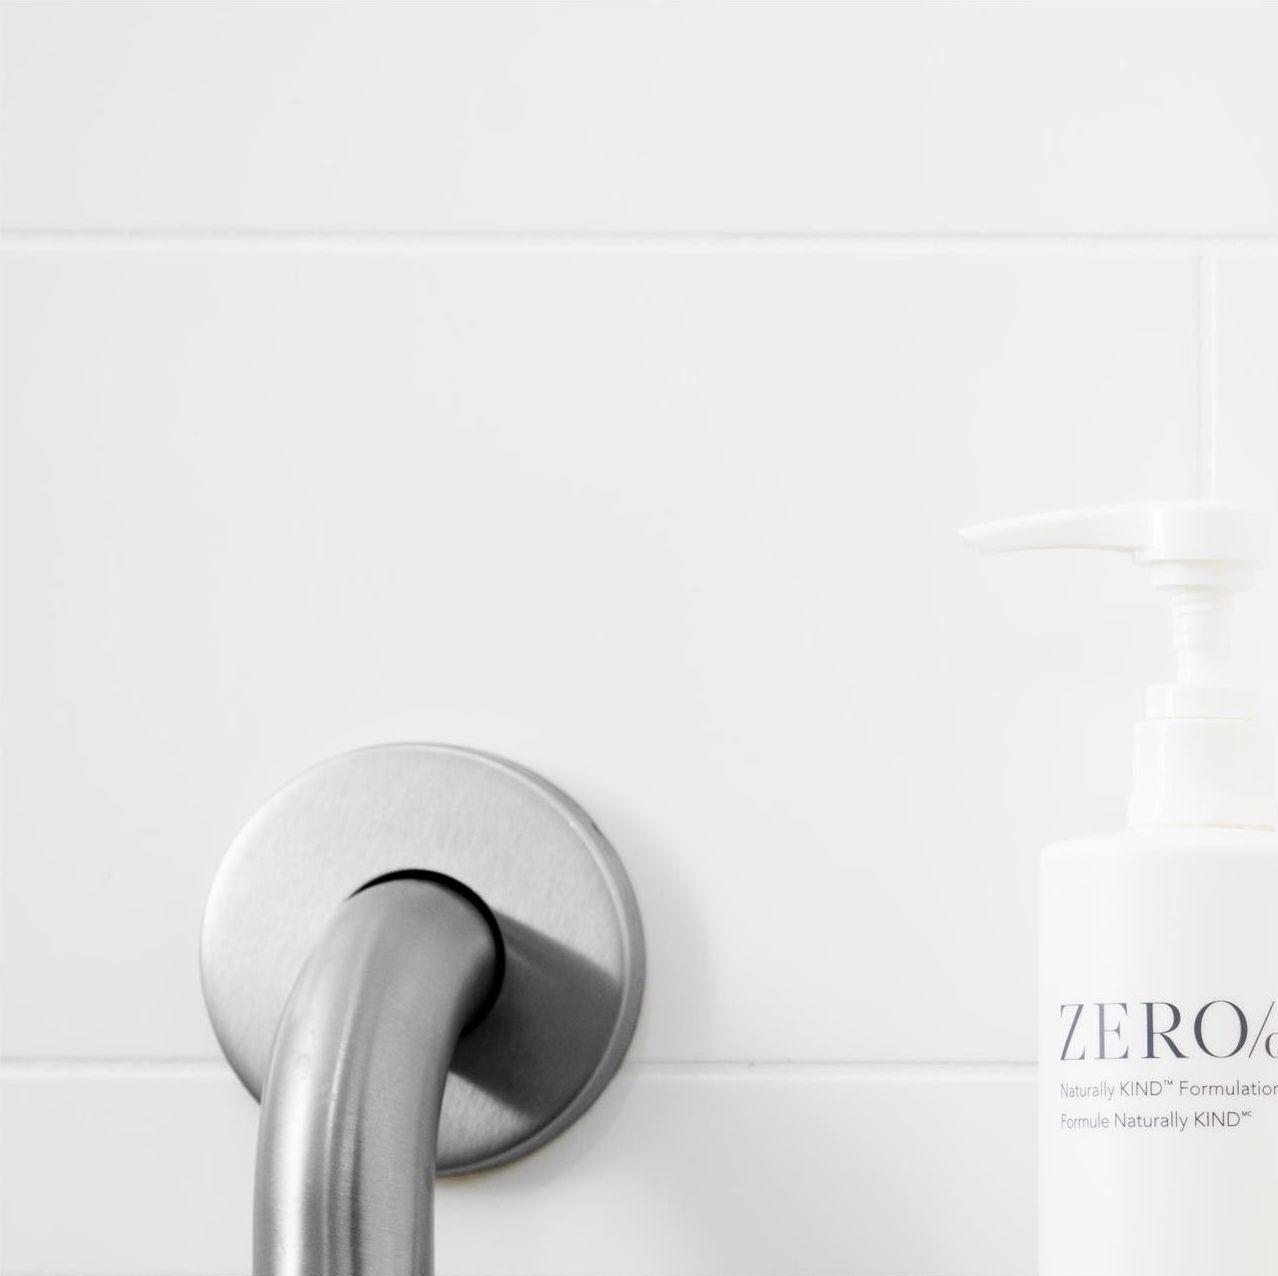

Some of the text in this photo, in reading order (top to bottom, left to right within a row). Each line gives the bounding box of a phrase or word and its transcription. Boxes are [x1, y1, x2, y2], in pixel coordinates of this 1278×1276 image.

[1060, 1081, 1115, 1101] Naturally
[1060, 1113, 1109, 1129] Formule
[1114, 1112, 1188, 1131] Naturally
